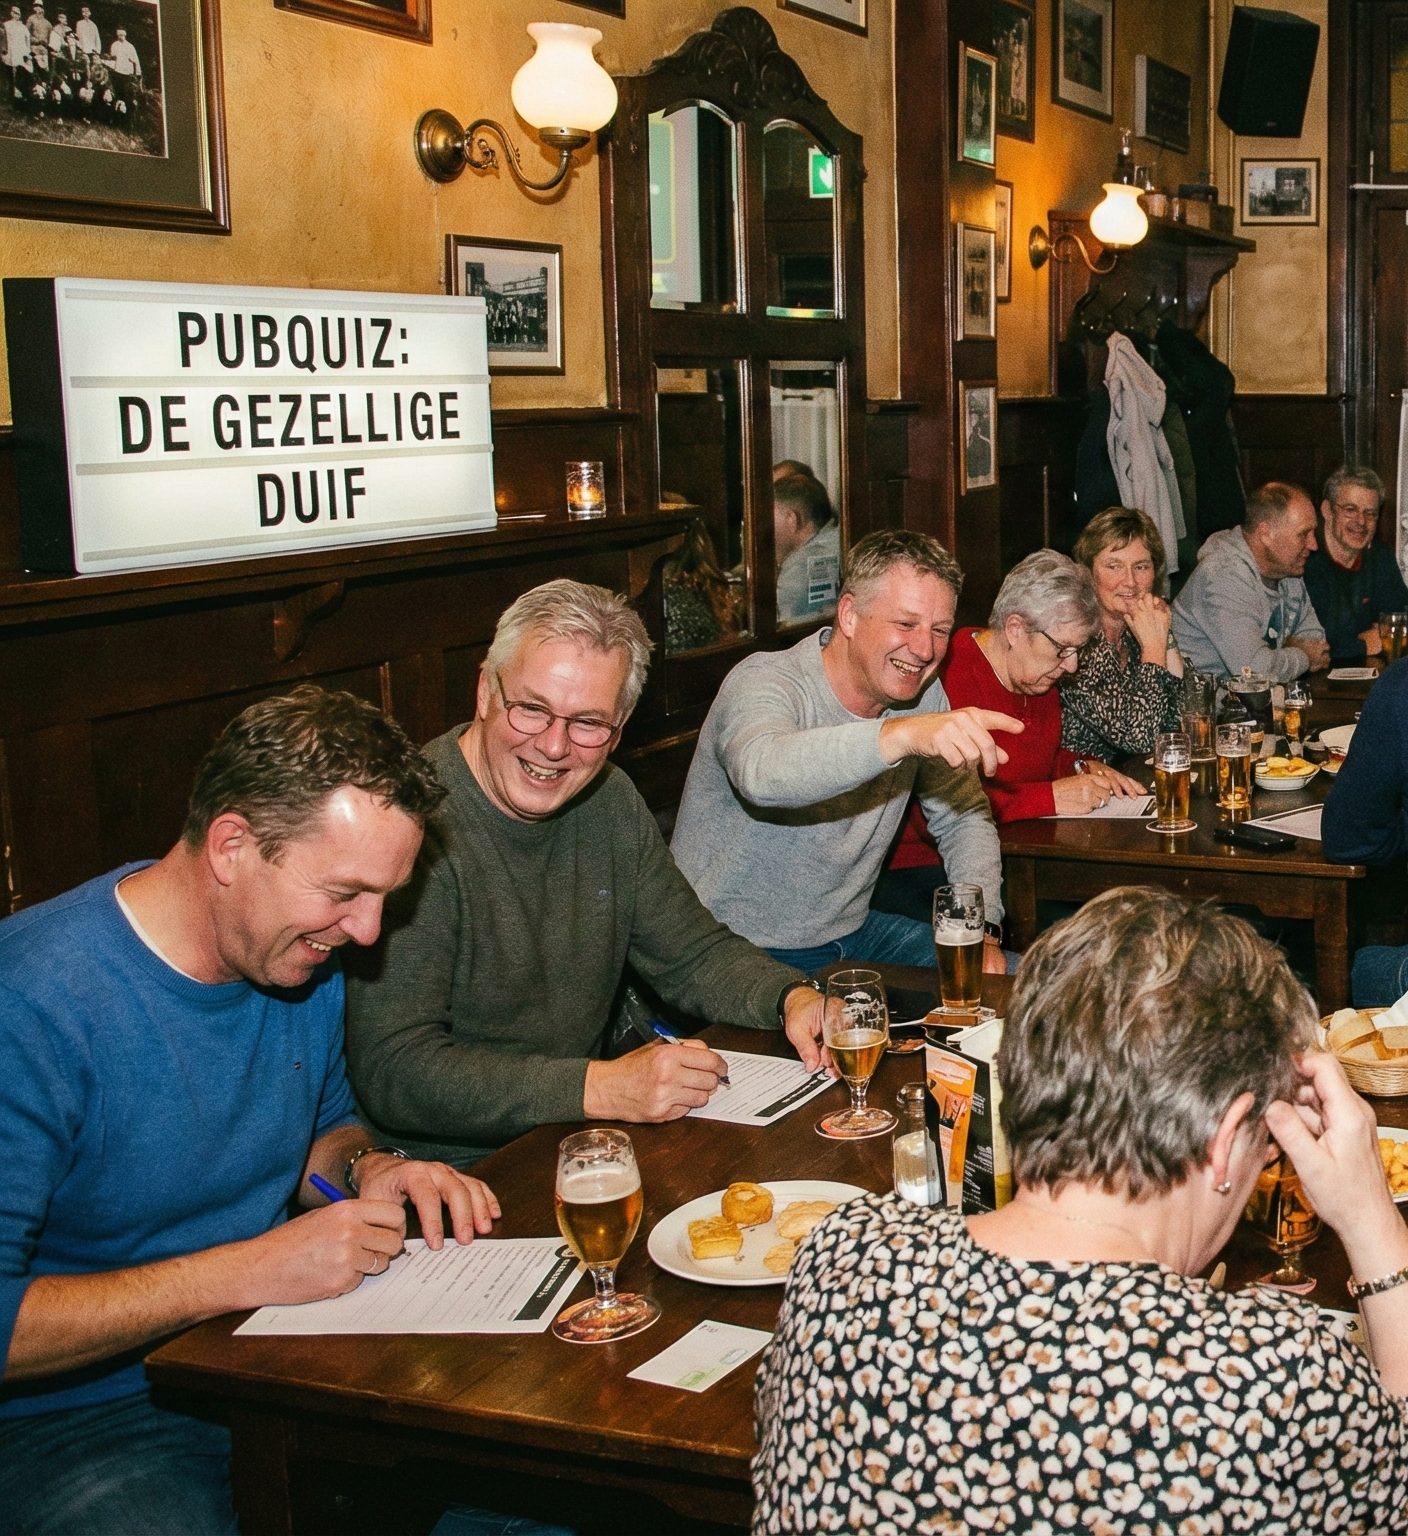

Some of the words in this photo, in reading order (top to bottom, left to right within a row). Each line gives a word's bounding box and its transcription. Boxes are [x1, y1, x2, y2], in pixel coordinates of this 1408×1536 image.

[178, 311, 409, 373] PUBQUIZ:
[118, 395, 191, 454] DE
[212, 391, 461, 450] GEZELLIGE
[257, 467, 366, 527] DUIF
